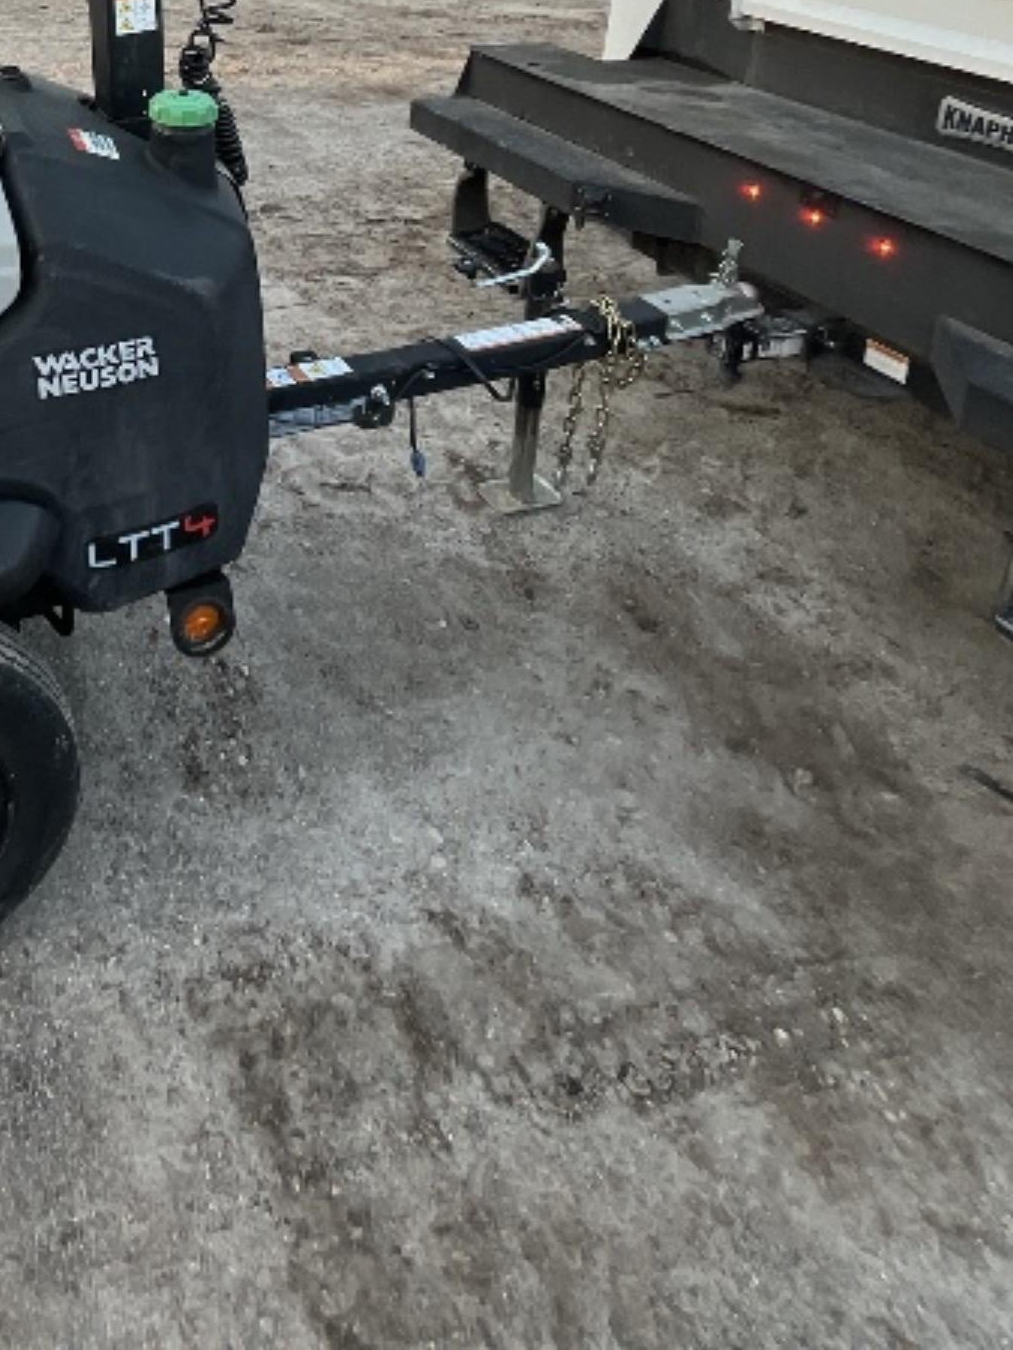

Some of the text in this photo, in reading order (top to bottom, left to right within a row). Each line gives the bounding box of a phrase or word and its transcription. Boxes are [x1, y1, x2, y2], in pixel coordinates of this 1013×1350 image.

[32, 336, 158, 377] WACKER
[37, 357, 160, 400] NEUSON
[87, 515, 216, 569] LTT4
